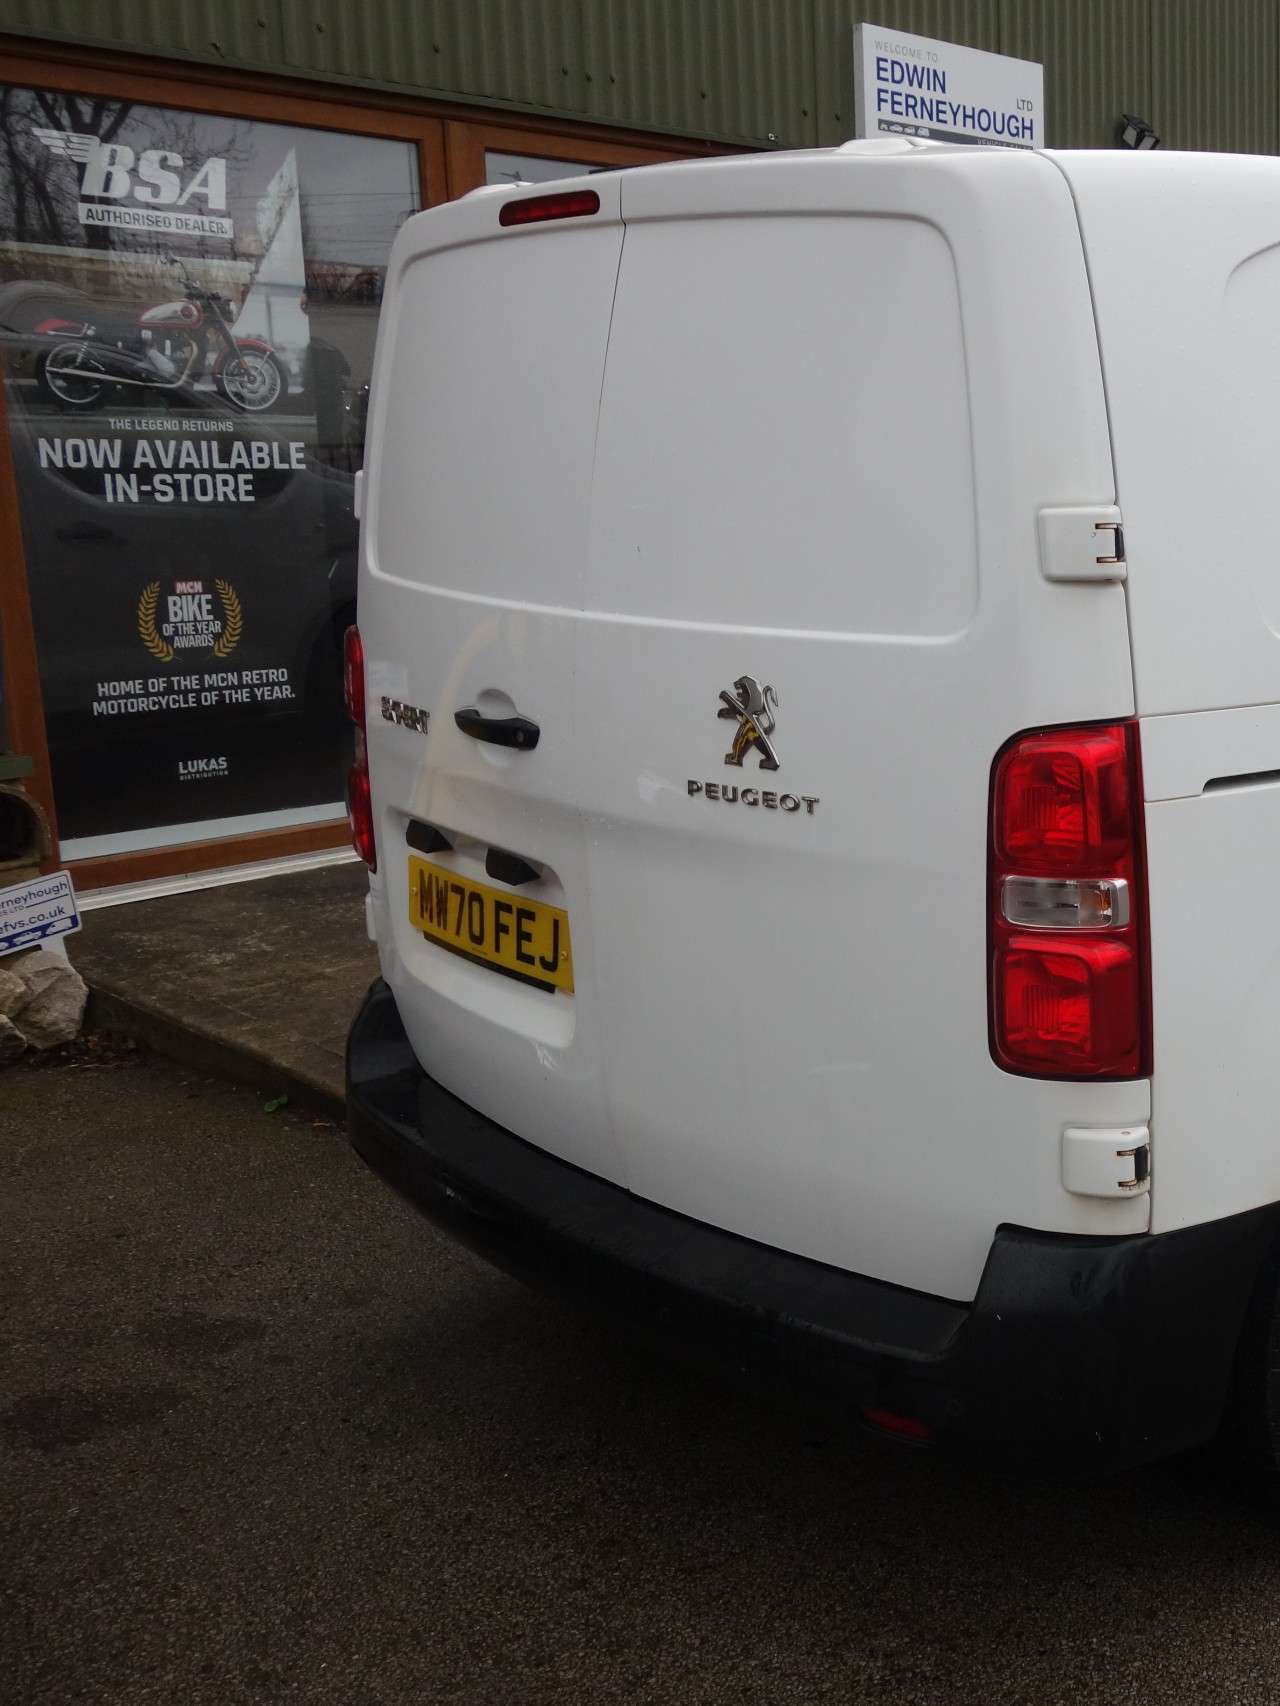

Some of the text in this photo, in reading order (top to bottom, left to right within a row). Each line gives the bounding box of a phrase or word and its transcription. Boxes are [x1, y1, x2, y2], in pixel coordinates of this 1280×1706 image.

[874, 39, 938, 63] WELCOME TO
[876, 56, 946, 94] EDWIN
[876, 87, 1034, 141] FERNEYHOUGH
[1016, 98, 1033, 112] LTD
[80, 141, 227, 211] BSA
[85, 207, 228, 235] AUTHORISED DEALER.
[108, 418, 234, 432] THE LEGEND RETURNS
[38, 437, 307, 471] NOW AVAILABLE
[103, 473, 256, 504] IN-STORE
[176, 581, 203, 594] MCN
[167, 594, 214, 623] BIKE
[162, 620, 222, 636] OF THE YEAR
[173, 633, 214, 649] AWARDS
[97, 668, 289, 697] HOME OF THE MCN RETRO
[92, 684, 296, 716] MOTORCYCLE OF THE YEAR.
[179, 756, 227, 773] LUKAS
[687, 779, 820, 815] PEUGEOT
[0, 881, 68, 909] rneyhough
[419, 868, 560, 973] MW70 FEJ
